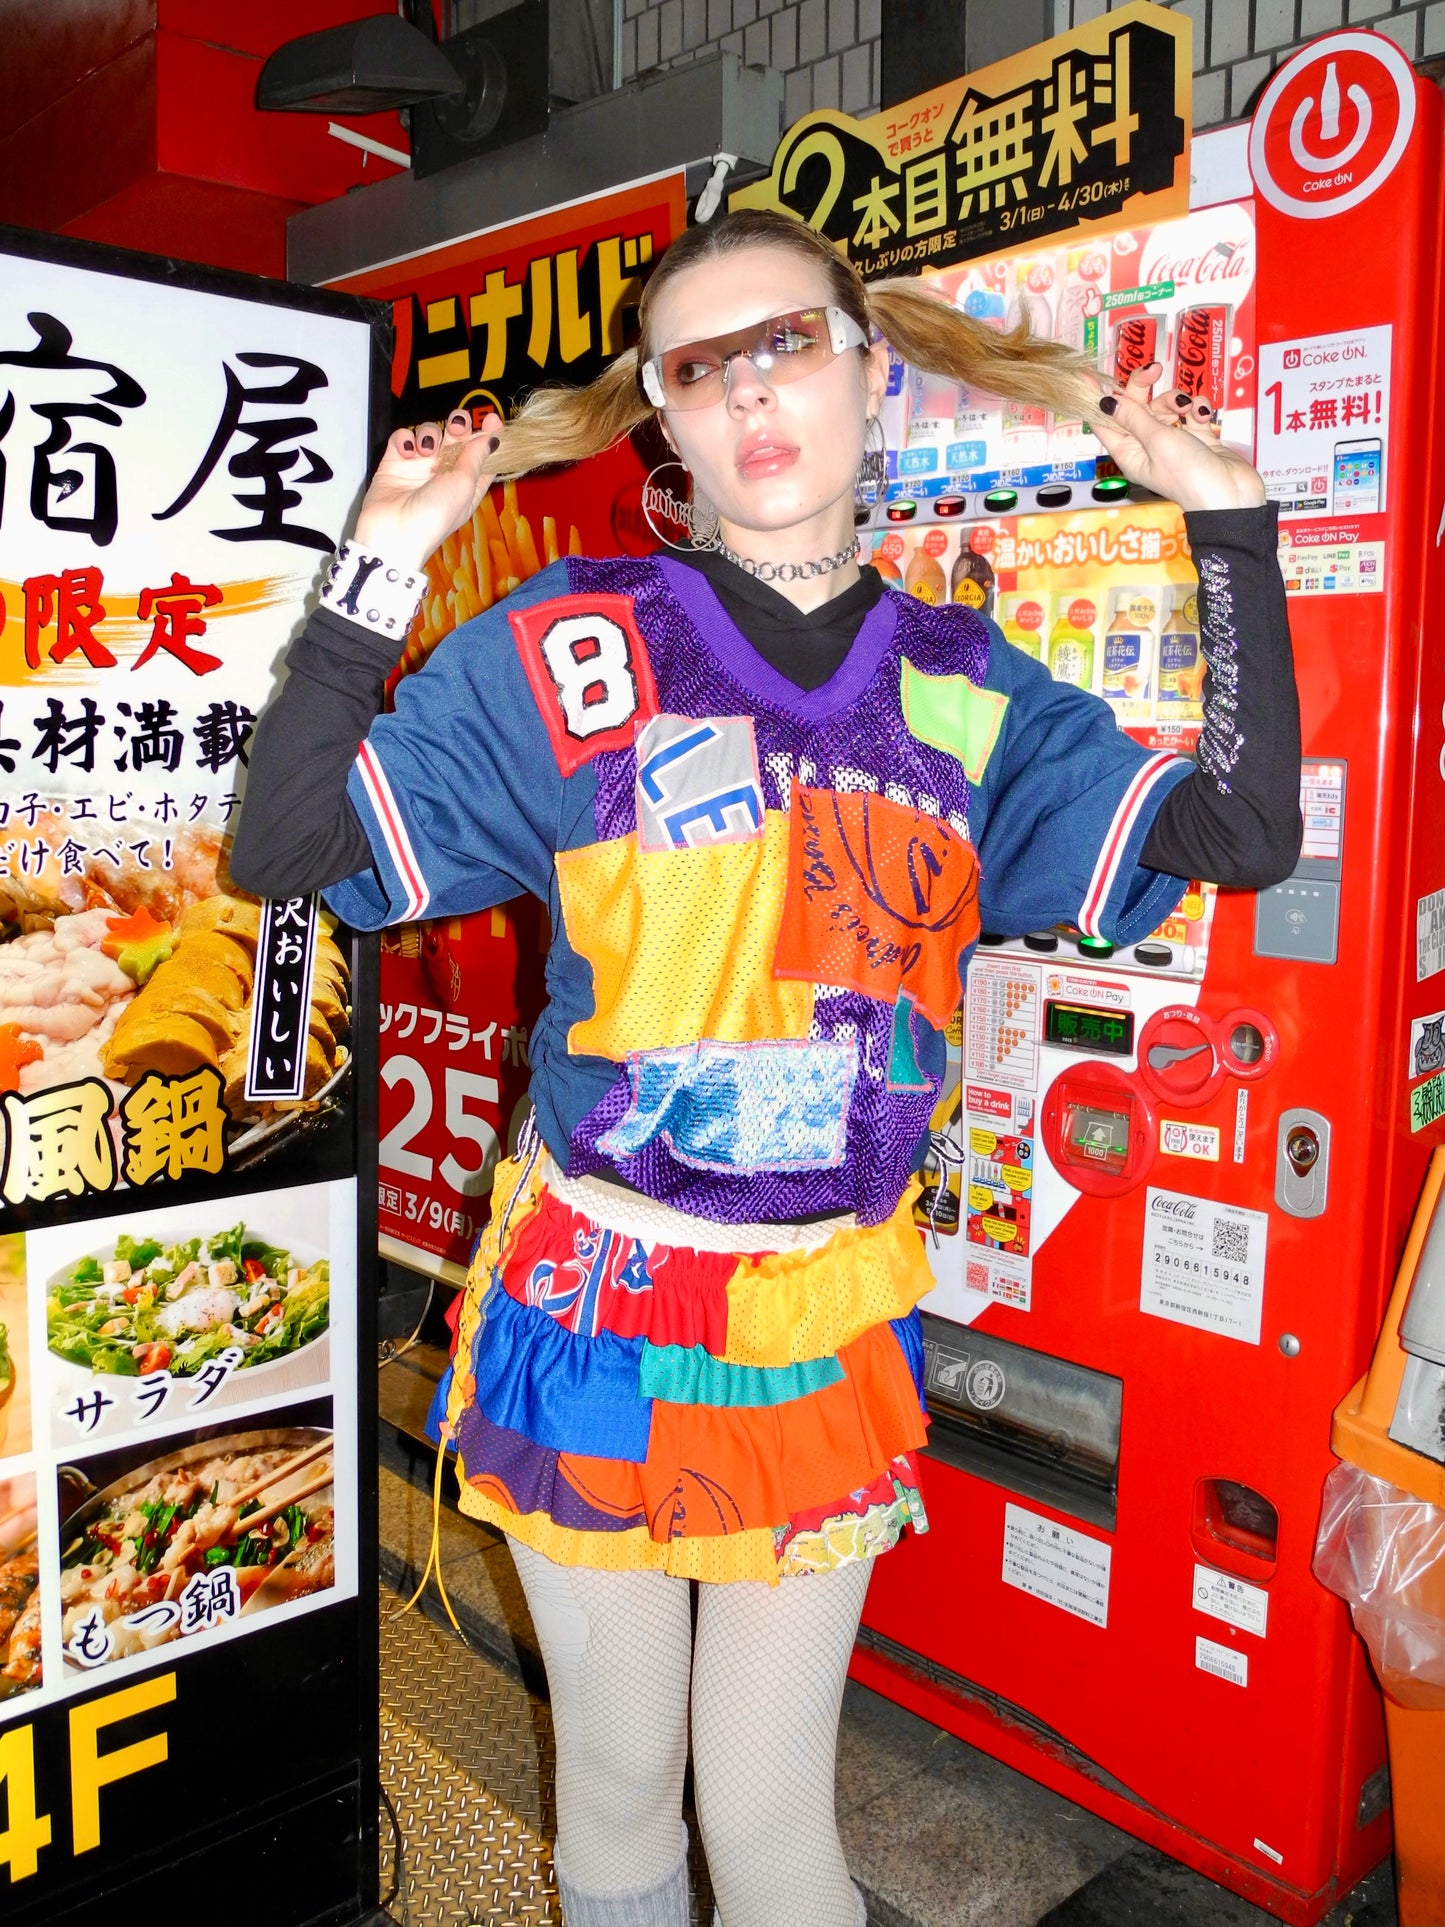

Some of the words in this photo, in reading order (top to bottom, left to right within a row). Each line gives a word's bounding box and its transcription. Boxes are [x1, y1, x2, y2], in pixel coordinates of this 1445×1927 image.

[886, 103, 944, 140] コークオン
[779, 33, 1139, 252] 2本目無料
[887, 129, 934, 158] で買うと
[1303, 179, 1332, 192] Coke
[1105, 282, 1173, 308] 250ml缶コーナー
[1303, 351, 1339, 366] Coke
[1309, 373, 1382, 392] スタンプたまると
[0, 312, 337, 553] 宿屋
[1002, 468, 1020, 477] ¥160
[1054, 461, 1073, 470] ¥160
[1295, 534, 1320, 545] Coke
[1339, 532, 1360, 544] Pay
[882, 545, 903, 554] 650
[955, 594, 981, 602] GEORGIA
[0, 566, 224, 676] 限定
[1106, 645, 1136, 656] 紅茶花伝
[1163, 645, 1193, 656] 紅茶花伝
[539, 612, 639, 740] 8
[1161, 725, 1181, 733] ¥150
[1066, 985, 1088, 998] Coke
[1106, 990, 1125, 1004] Pay
[1057, 1013, 1124, 1043] 販売中
[968, 1088, 983, 1096] How
[968, 1096, 983, 1105] buy
[990, 1100, 1010, 1111] drink
[379, 1054, 530, 1197] 25
[1188, 1133, 1216, 1144] 使えます
[1088, 1145, 1104, 1157] 1000
[1192, 1142, 1210, 1156] OK
[1168, 1237, 1194, 1251] こちらから
[64, 1347, 242, 1431] サラダ
[1229, 1581, 1244, 1594] 警告
[73, 1568, 239, 1661] もつ鍋
[0, 1672, 177, 1884] 4F
